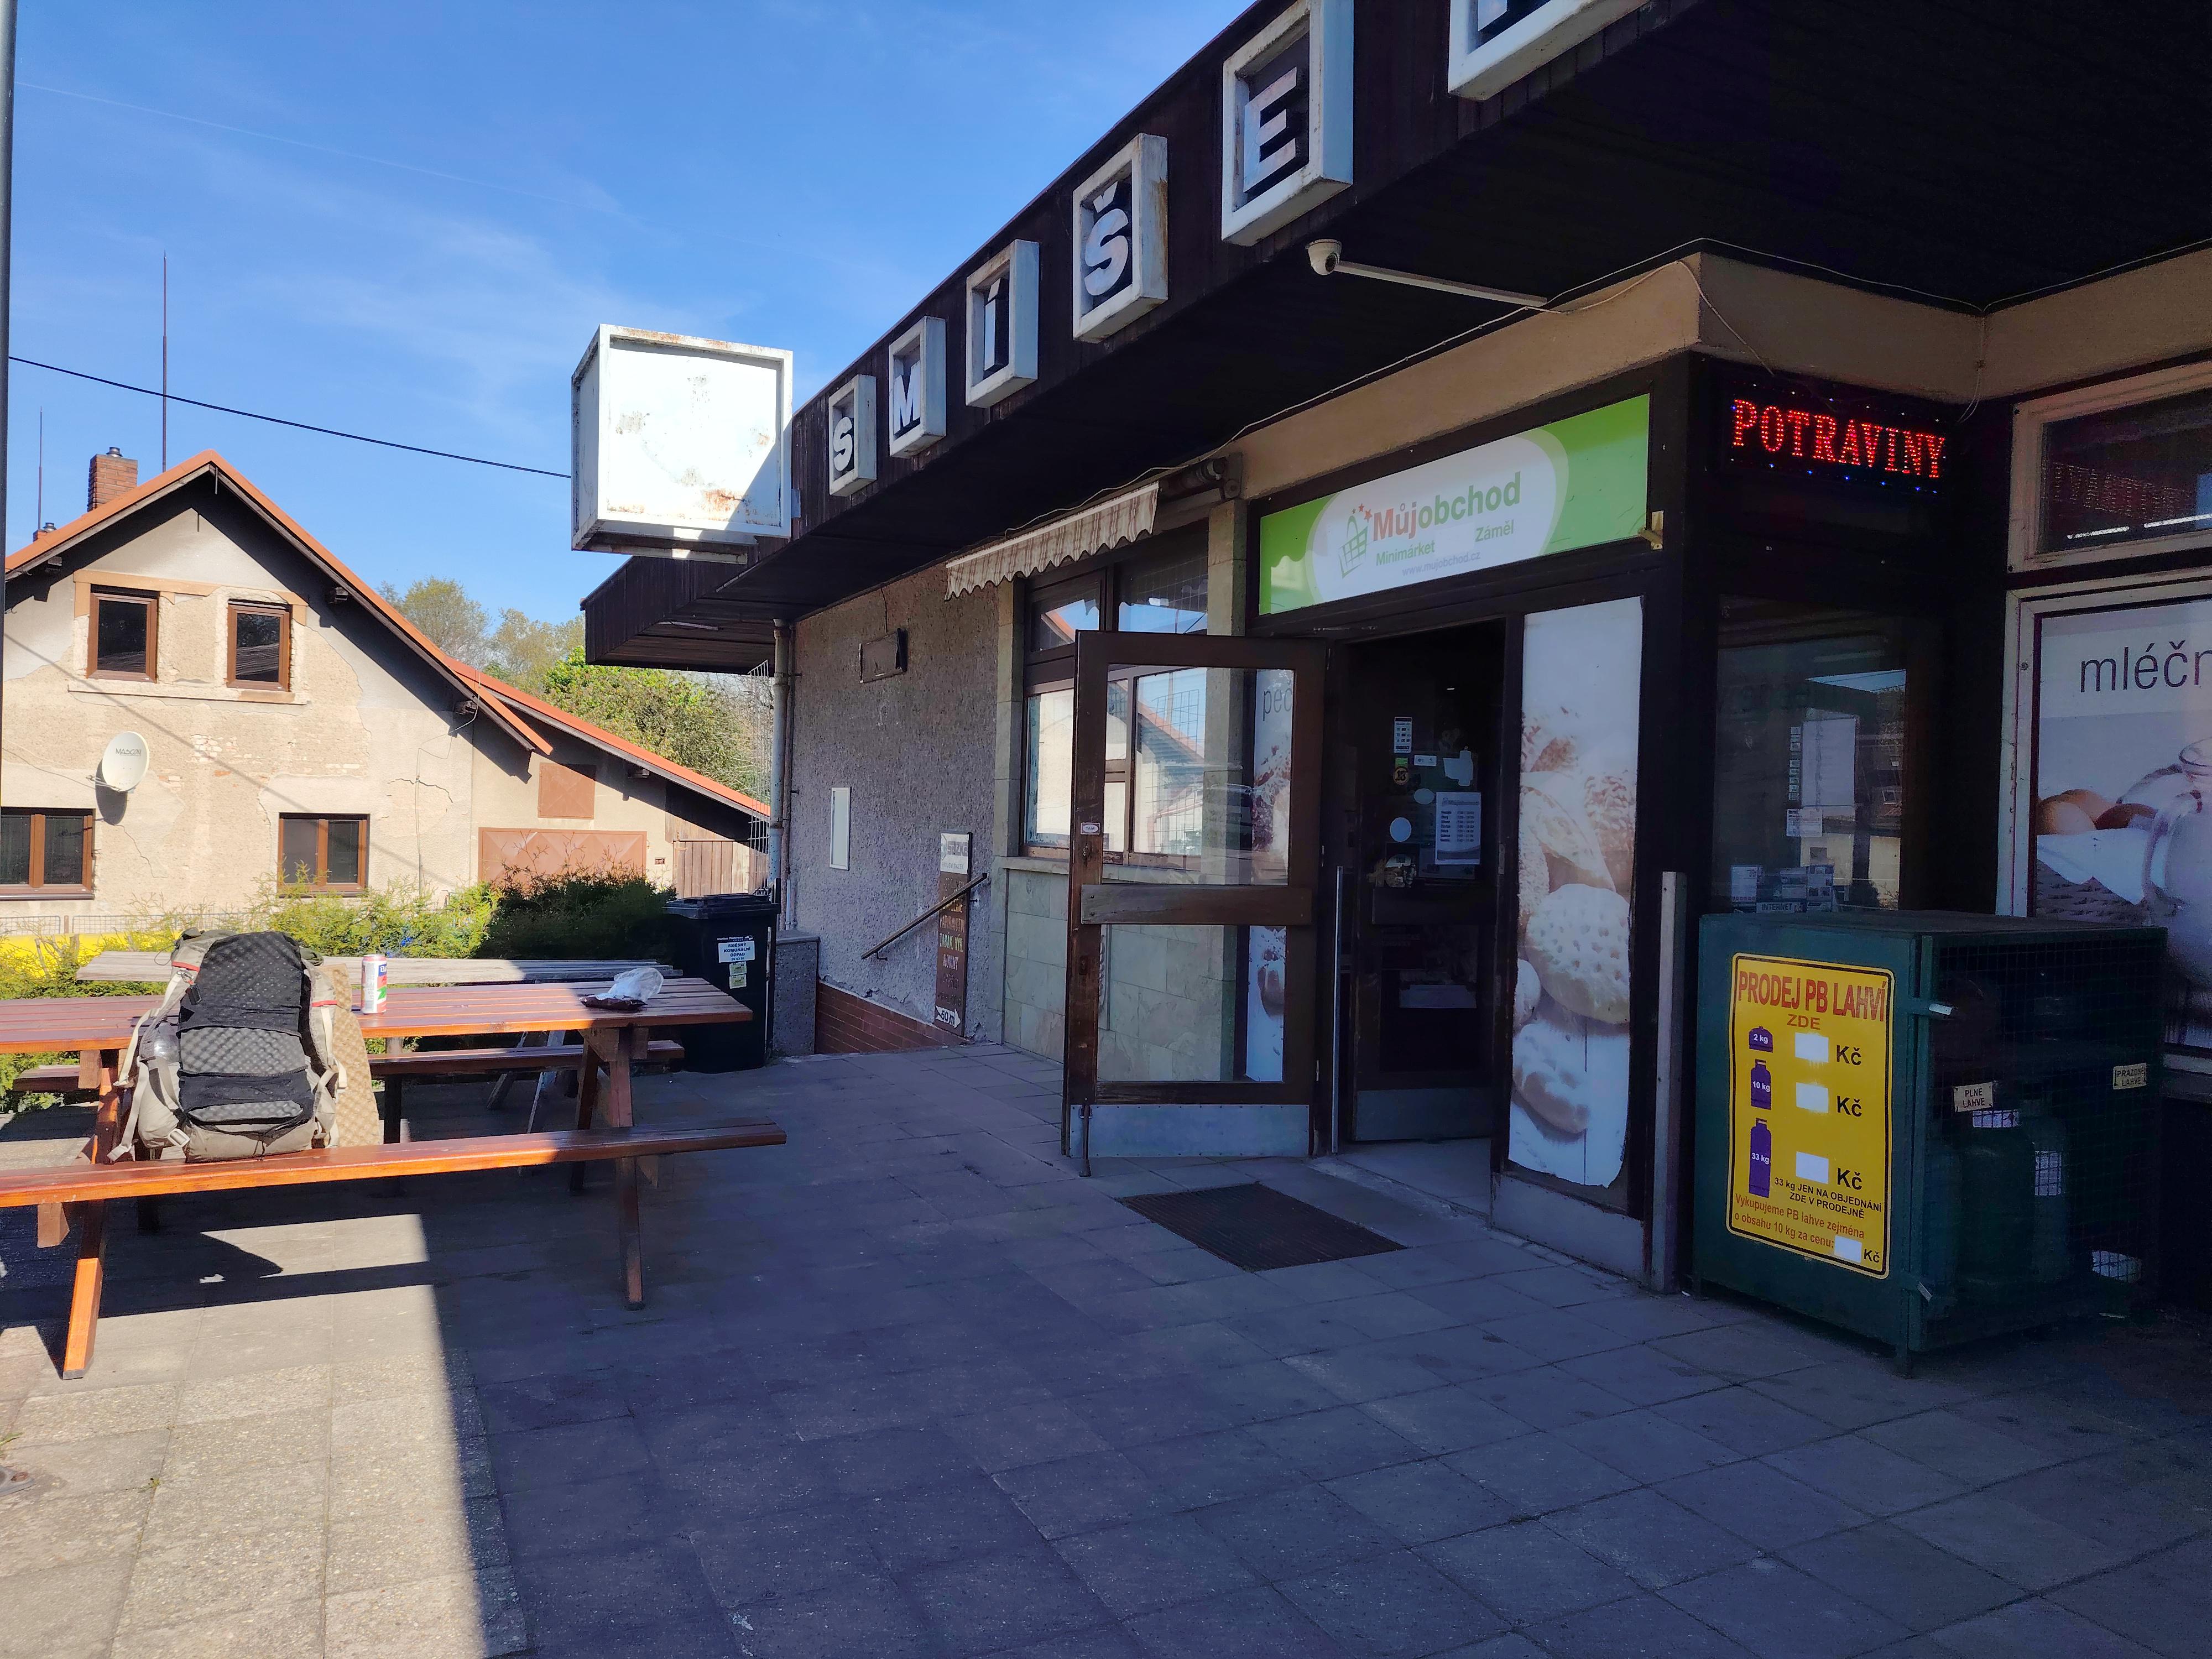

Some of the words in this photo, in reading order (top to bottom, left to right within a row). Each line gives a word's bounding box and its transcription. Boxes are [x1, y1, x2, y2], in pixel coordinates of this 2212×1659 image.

[1732, 399, 1945, 478] POTRAVINY
[1373, 471, 1521, 541] Můjobchod
[1475, 519, 1514, 542] Záměl
[1402, 552, 1481, 577] www.mujobchod.cz
[1761, 902, 1792, 911] INTERNET
[1738, 971, 1801, 1010] PRODEJ
[1806, 979, 1828, 1013] PB
[1833, 981, 1887, 1021] LAHVÍ
[1787, 1014, 1820, 1030] ZDE
[1759, 1034, 1768, 1044] kg
[1837, 1045, 1861, 1066] Kč
[1752, 1081, 1760, 1089] 10
[1762, 1082, 1770, 1092] kg
[1837, 1095, 1862, 1117] Kč
[1963, 1098, 1985, 1108] LAHVE
[1751, 1152, 1760, 1161] 33
[1761, 1154, 1770, 1165] kg
[1837, 1167, 1862, 1190] Kč
[1775, 1177, 1783, 1186] 33
[1786, 1180, 1795, 1191] kg
[1797, 1183, 1813, 1194] JEN
[1817, 1187, 1828, 1198] NA
[1830, 1191, 1881, 1212] OBJEDNÁNÍ
[1790, 1192, 1806, 1203] ZDE
[1808, 1197, 1814, 1206] V
[1817, 1199, 1864, 1219] PRODEJNĚ
[1735, 1193, 1784, 1217] Vykupujeme
[1787, 1207, 1798, 1220] PB
[1801, 1212, 1824, 1227] lahve
[1827, 1221, 1864, 1239] zejména
[1742, 1213, 1771, 1229] obsahu
[1773, 1221, 1783, 1233] 10
[1785, 1224, 1796, 1239] kg
[1798, 1232, 1807, 1240] za
[1811, 1234, 1834, 1248] cenu:
[1864, 1248, 1880, 1263] Kč
